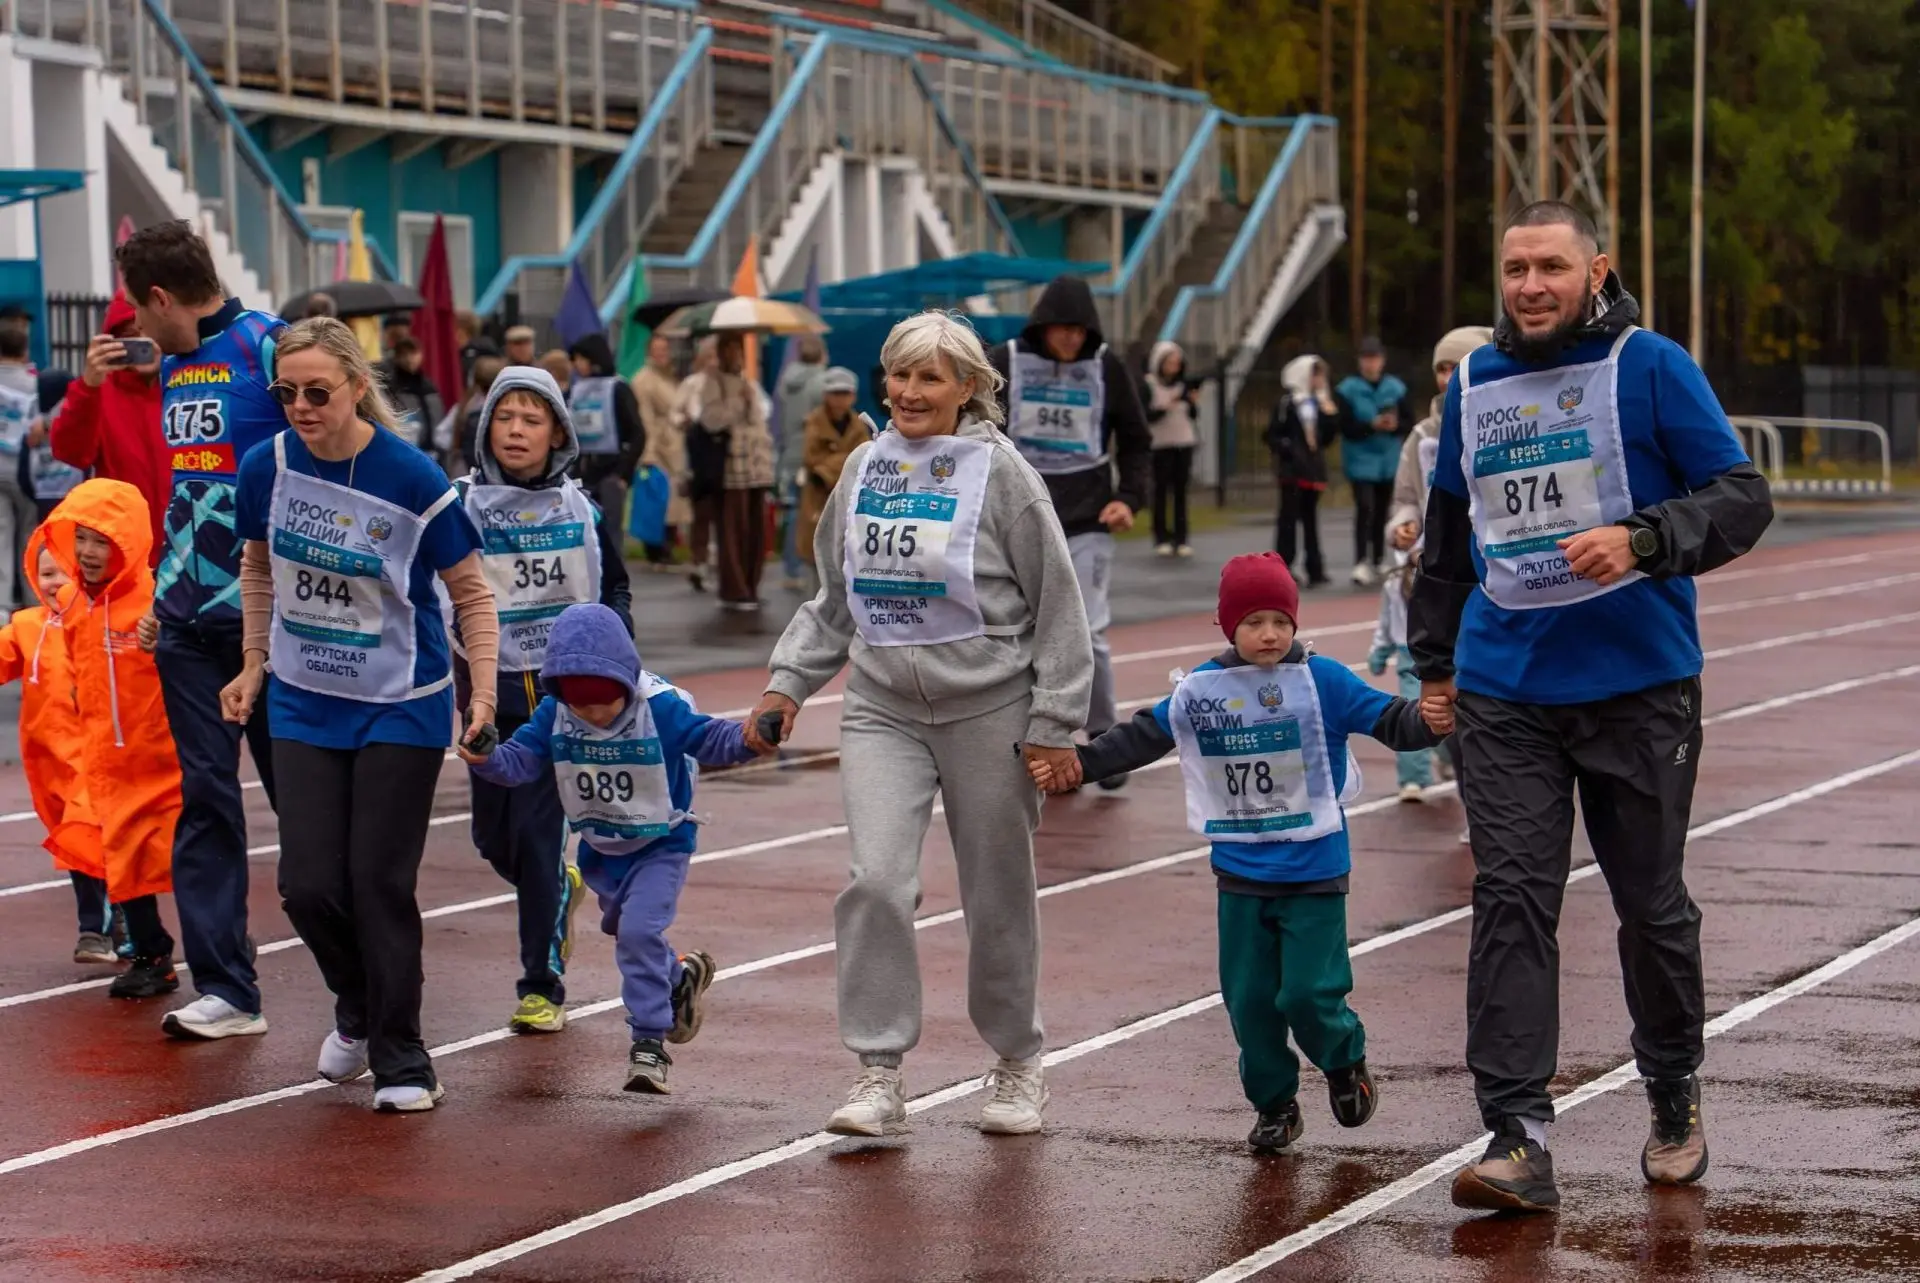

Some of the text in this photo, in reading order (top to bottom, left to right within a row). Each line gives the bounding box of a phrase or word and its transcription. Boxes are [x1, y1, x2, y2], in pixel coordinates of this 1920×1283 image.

[166, 401, 223, 442] 175
[1038, 407, 1074, 428] 945
[1477, 405, 1520, 430] КРОСС
[1477, 420, 1538, 449] НАЦИИ
[1510, 443, 1545, 459] КРОСС
[866, 459, 900, 475] РОСС
[884, 498, 915, 510] КРОСС
[1504, 472, 1563, 515] 874
[288, 497, 338, 525] КРОСС
[284, 515, 348, 546] НАЦИИ
[519, 533, 552, 543] КРОСС
[1506, 519, 1578, 537] ИРКУТСКАЯ ОБЛАСТЬ
[865, 522, 918, 558] 815
[306, 546, 340, 564] КРОСС
[513, 556, 567, 589] 354
[1516, 556, 1569, 576] ИРКУТСК
[296, 570, 353, 607] 844
[870, 613, 924, 625] ОБЛАСТЬ
[511, 622, 553, 639] ИРКУТС
[301, 643, 367, 664] ИРКУТСКАЯ
[306, 659, 358, 678] ОБЛАСТЬ
[1224, 733, 1258, 746] КРОСС
[584, 745, 620, 756] КРОСС
[576, 771, 634, 803] 989
[1225, 761, 1273, 796] 878
